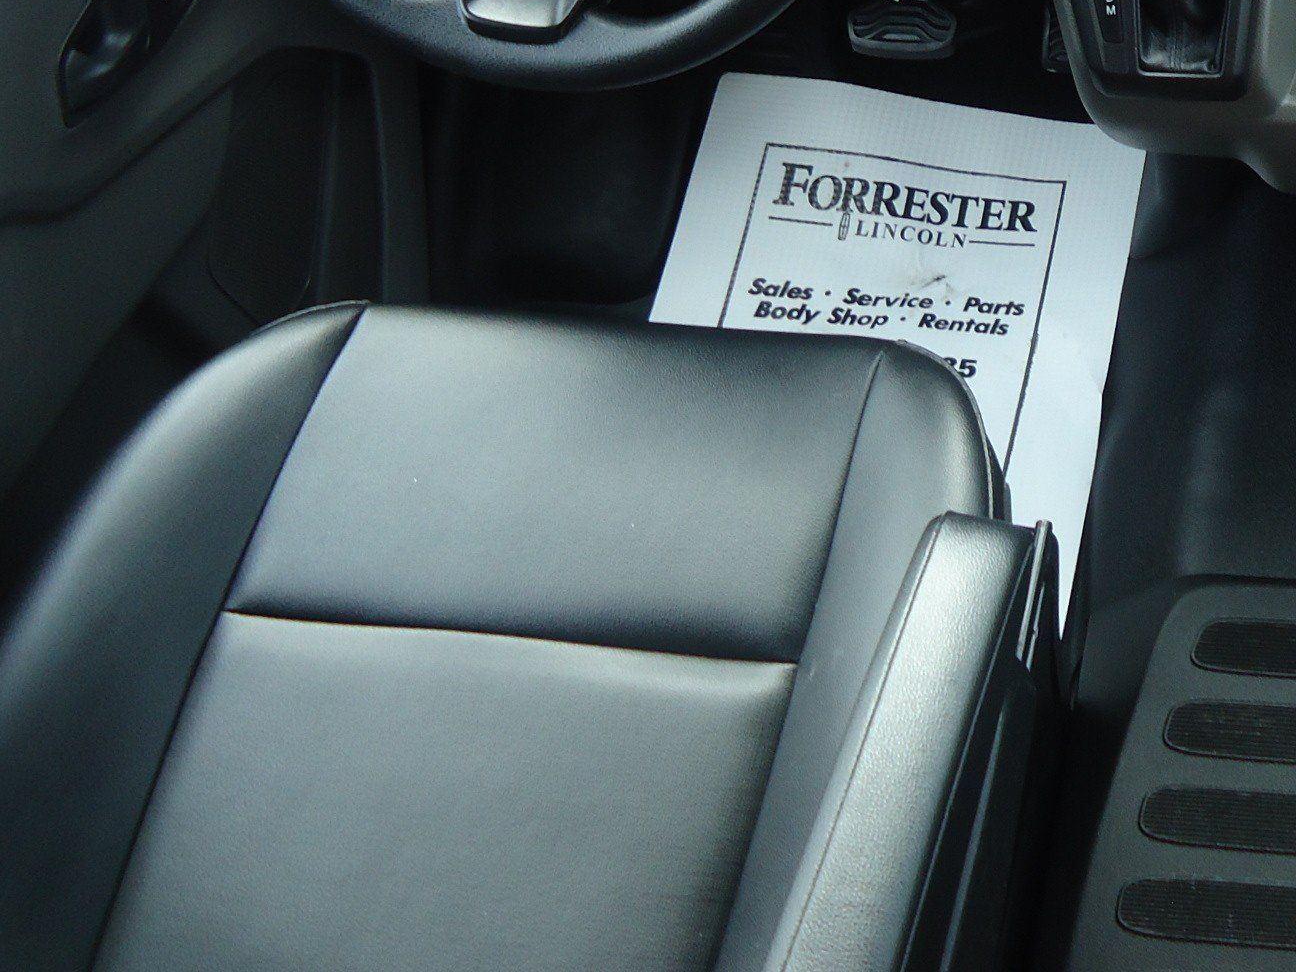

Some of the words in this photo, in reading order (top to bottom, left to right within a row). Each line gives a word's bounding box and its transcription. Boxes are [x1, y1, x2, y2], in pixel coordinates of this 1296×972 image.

[1106, 5, 1116, 16] M
[772, 162, 1038, 233] FORRESTER
[855, 219, 968, 249] LINCOLN
[748, 278, 814, 301] Sales
[842, 287, 934, 310] Service
[963, 296, 1026, 317] Parts
[753, 300, 821, 326] Body
[826, 307, 890, 329] Shop
[918, 312, 1010, 336] Rentals
